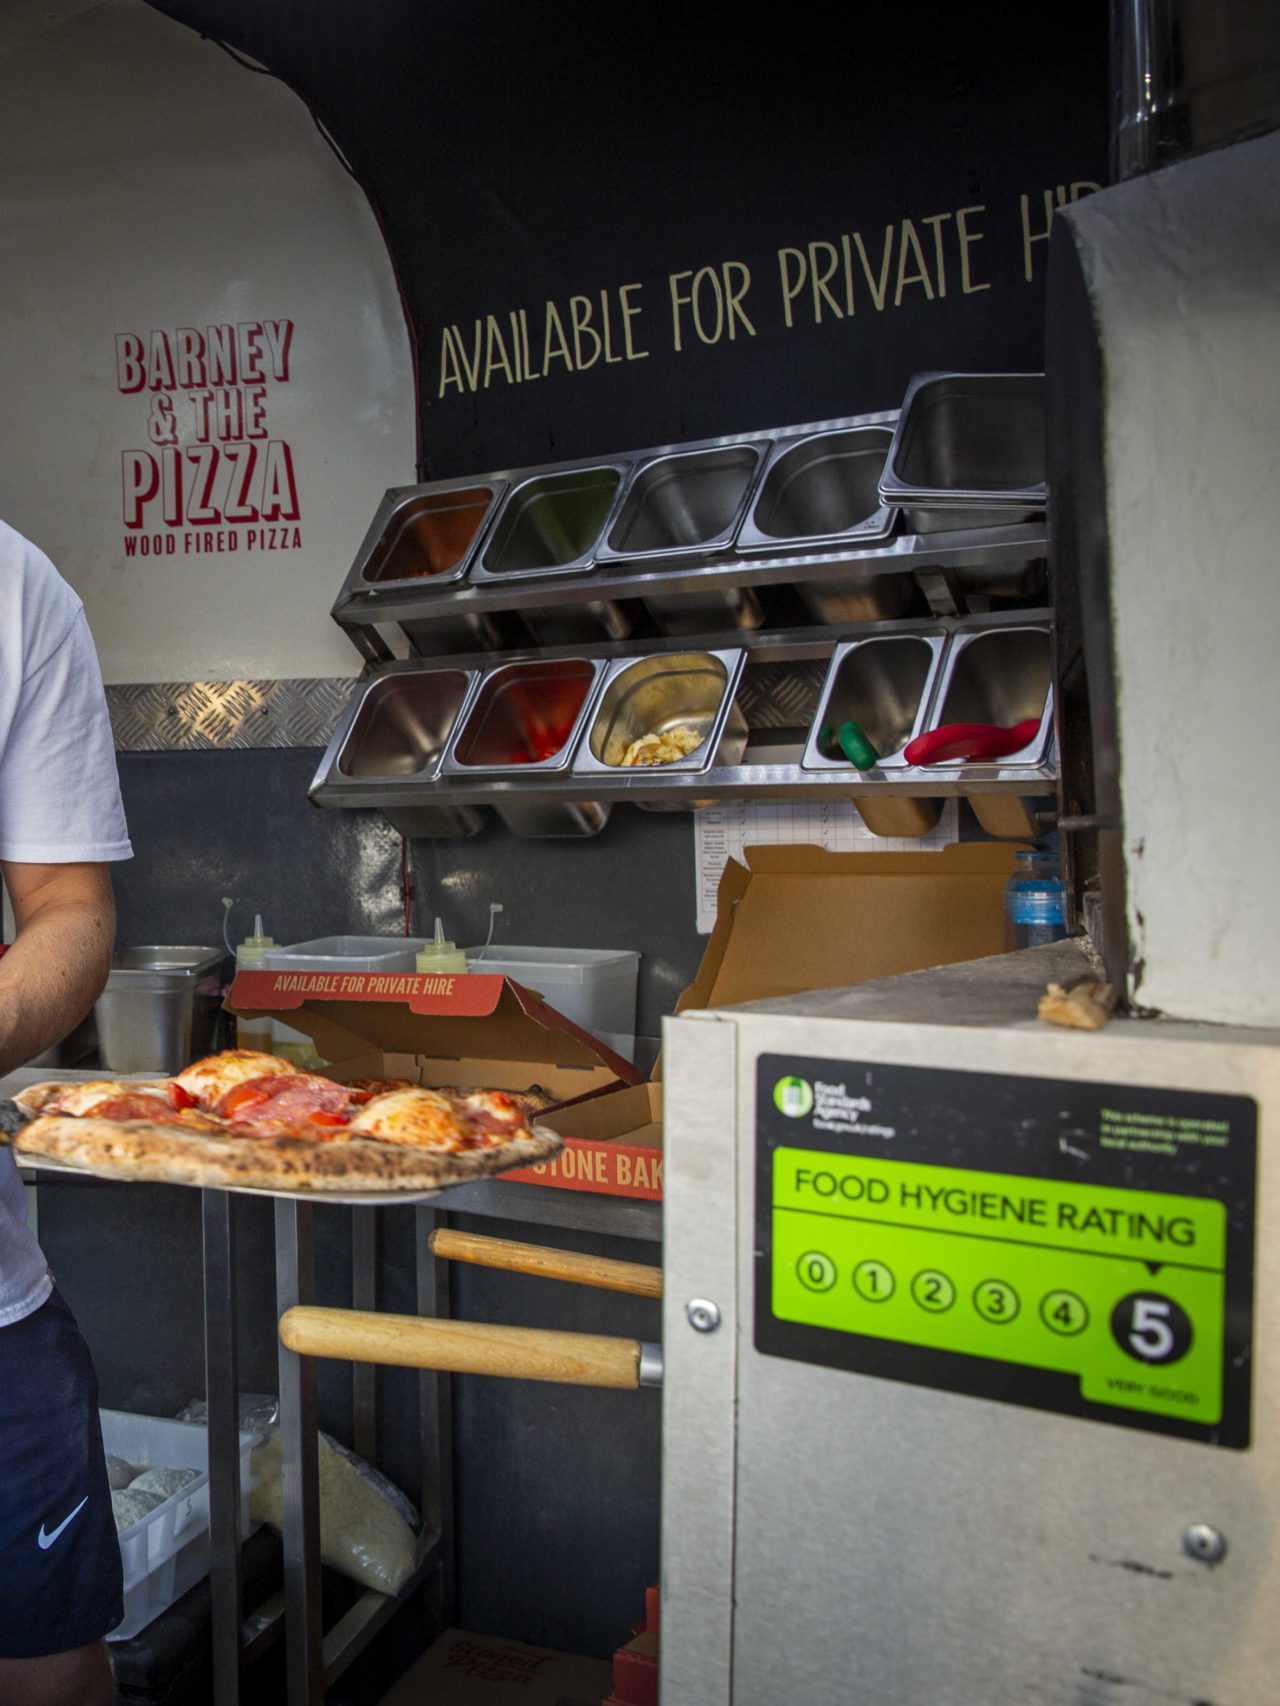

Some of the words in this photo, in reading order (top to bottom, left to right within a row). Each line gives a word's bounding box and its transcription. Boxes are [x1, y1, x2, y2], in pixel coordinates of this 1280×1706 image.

[439, 283, 649, 398] AVAILABLE
[669, 261, 756, 351] FOR
[778, 205, 990, 327] PRIVATE
[115, 319, 294, 394] BARNEY
[148, 392, 178, 446] &
[188, 386, 269, 442] THE
[121, 440, 301, 529] PIZZA
[124, 534, 175, 556] WOOD
[184, 531, 238, 554] FIRED
[247, 527, 302, 550] PIZZA
[273, 975, 339, 992] AVAILABLE
[340, 976, 365, 993] FOR
[367, 977, 421, 995] PRIVATE
[423, 978, 456, 996] HIRE
[795, 1169, 889, 1203] FOOD
[900, 1183, 1047, 1226] HYGIENE
[1058, 1203, 1195, 1247] RATING
[808, 1259, 825, 1284] 0
[868, 1270, 878, 1293] 1
[925, 1278, 942, 1304] 2
[987, 1289, 1005, 1315] 3
[1053, 1301, 1071, 1326] 4
[1129, 1299, 1174, 1359] 5
[1106, 1376, 1143, 1393] VERY
